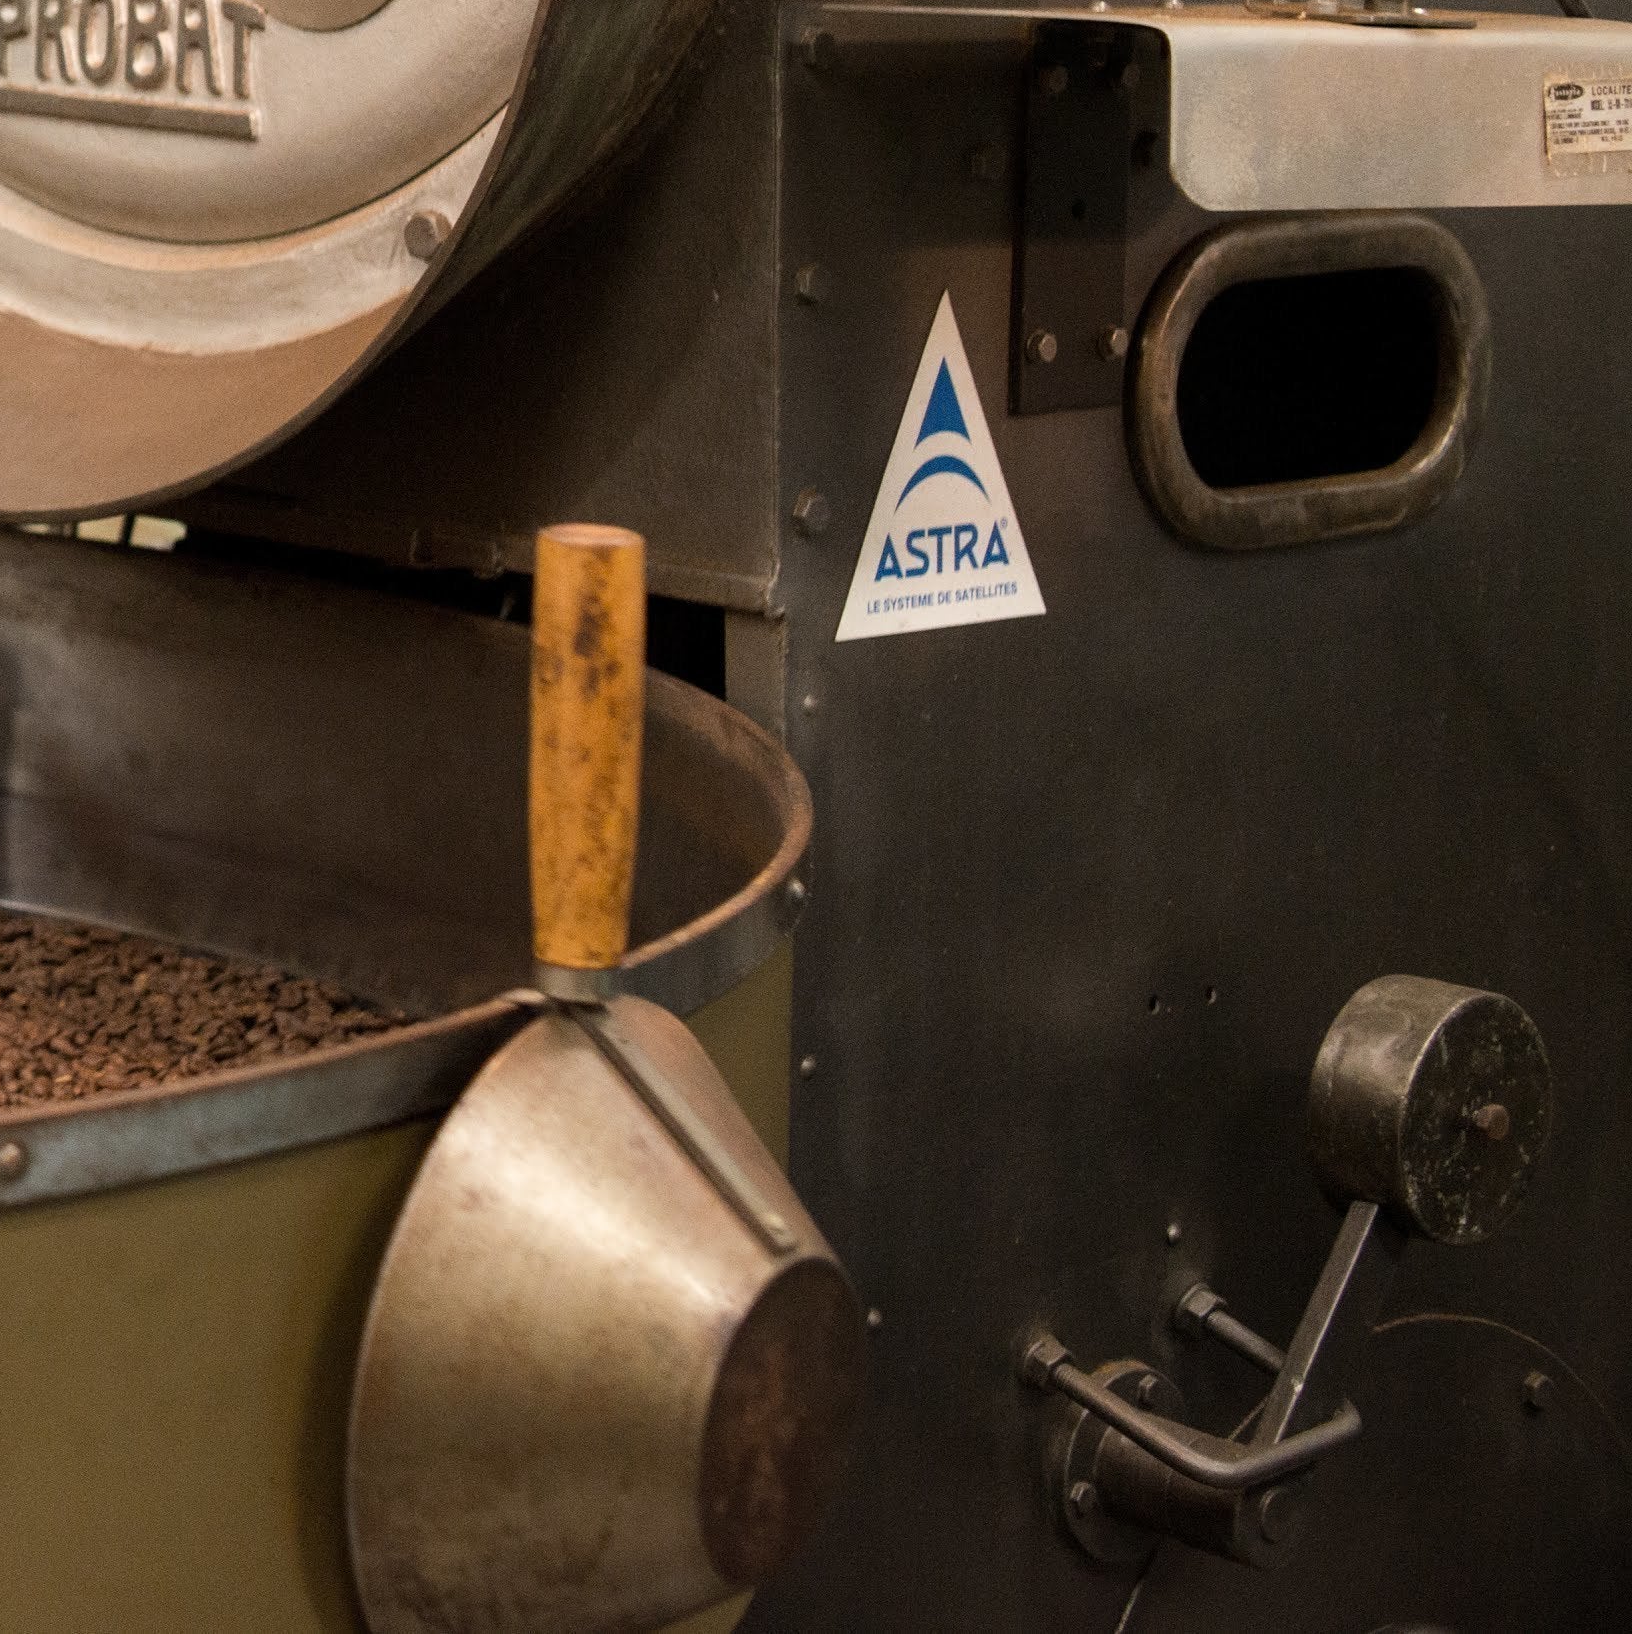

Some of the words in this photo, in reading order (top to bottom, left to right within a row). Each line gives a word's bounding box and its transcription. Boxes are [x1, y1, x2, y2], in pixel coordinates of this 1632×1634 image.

[873, 519, 1011, 583] ASTRA
[867, 599, 880, 615] LE
[937, 589, 952, 606] DE
[955, 580, 1019, 602] SATELLITES
